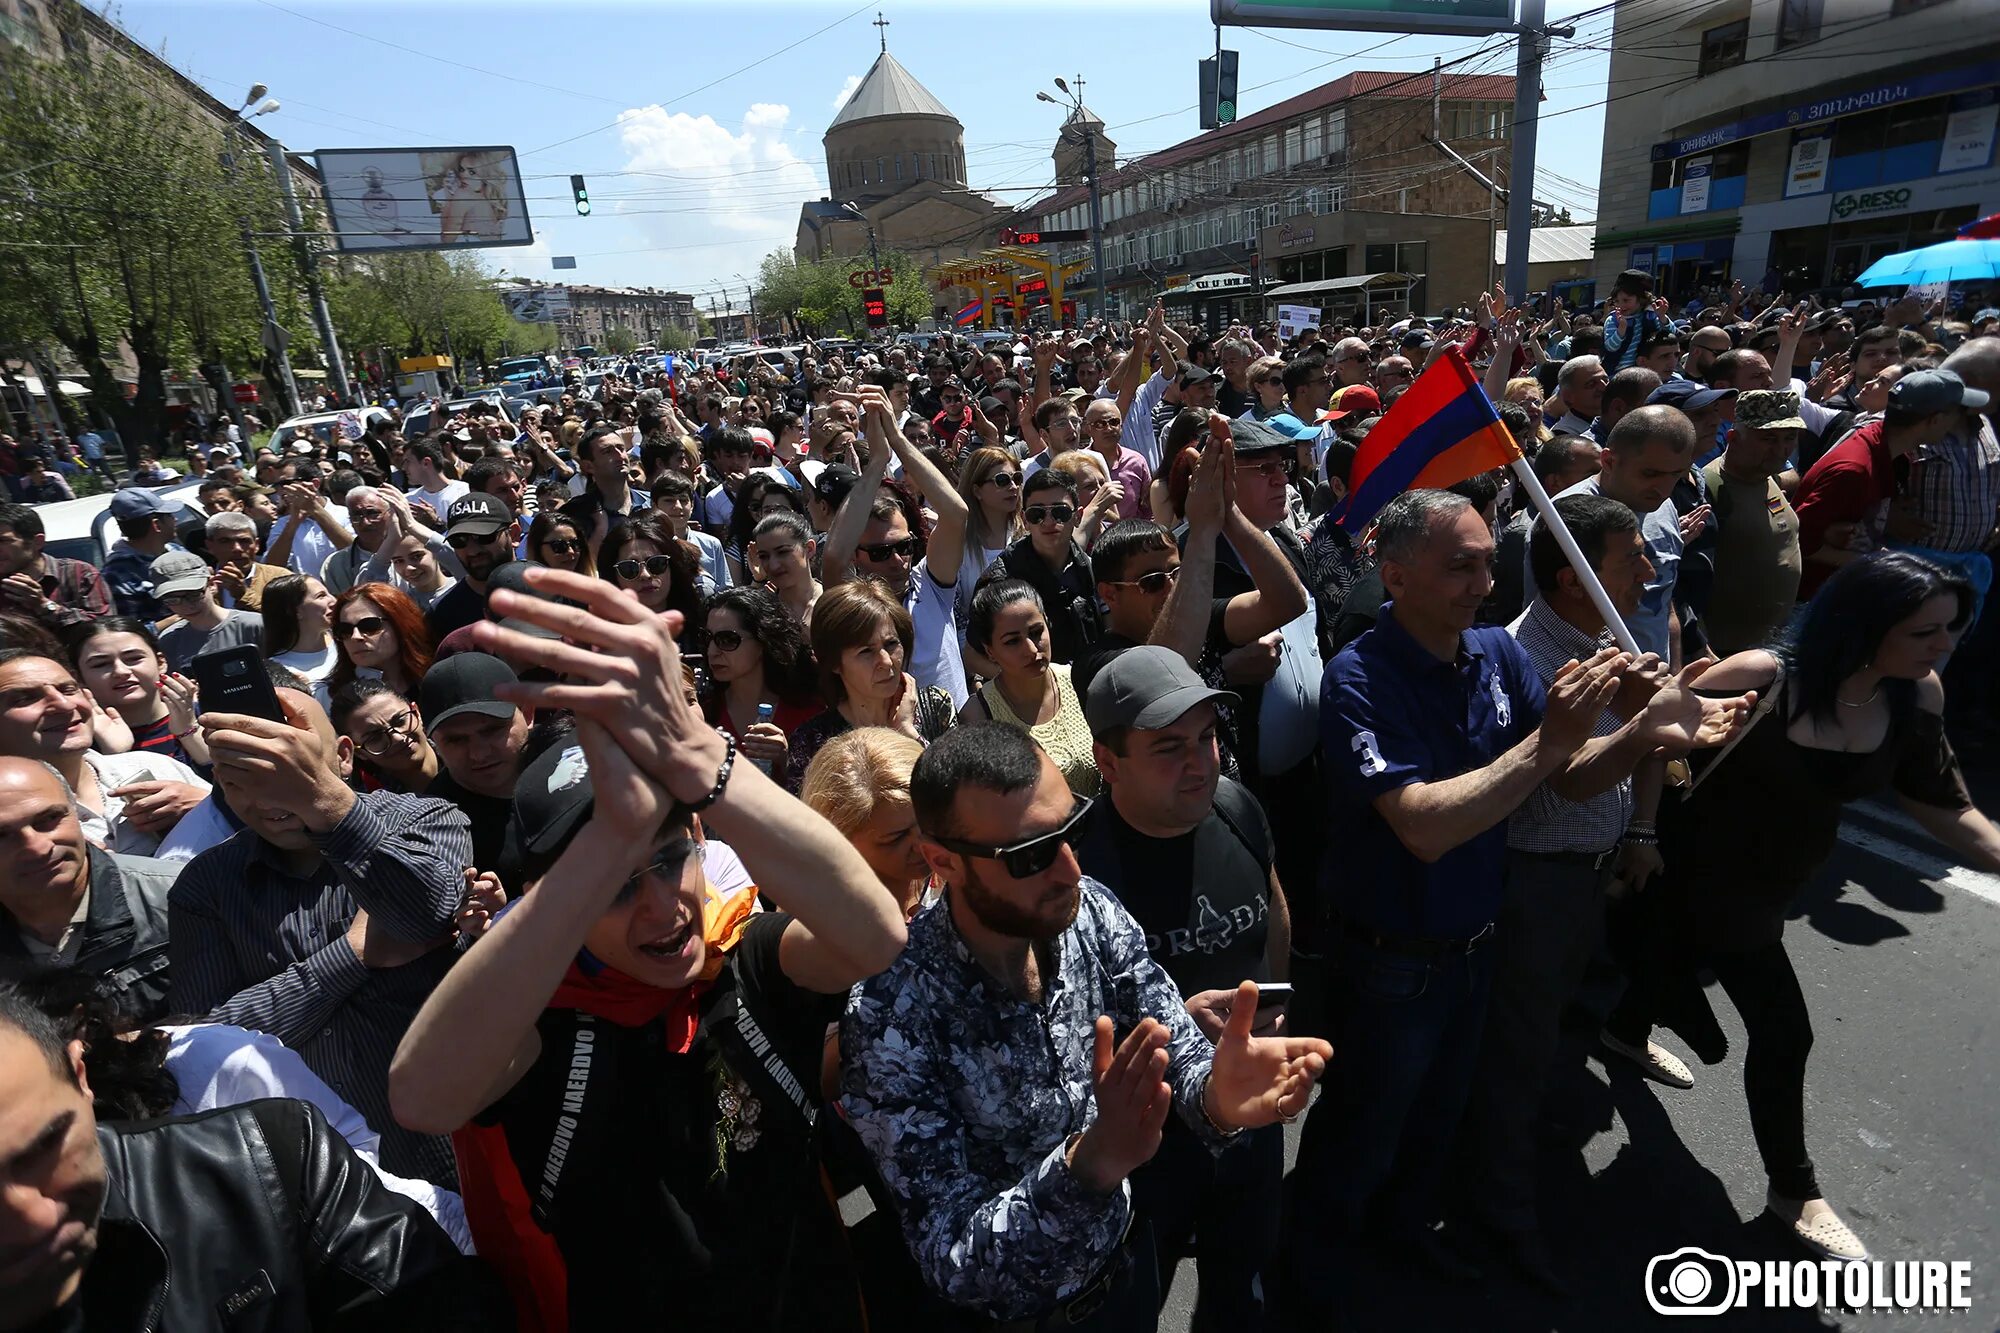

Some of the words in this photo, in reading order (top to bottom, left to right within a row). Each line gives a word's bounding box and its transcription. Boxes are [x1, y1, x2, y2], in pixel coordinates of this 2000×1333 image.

[1680, 130, 1725, 153] ЮНИБАНК
[1859, 188, 1912, 208] RESO
[1018, 233, 1041, 244] CPS
[848, 267, 895, 288] CPS
[450, 500, 490, 517] ASALA
[223, 683, 253, 695] SAMSUNG
[1350, 731, 1387, 777] 3
[543, 1115, 578, 1186] NAERDVO
[562, 1029, 596, 1113] NAERDVO
